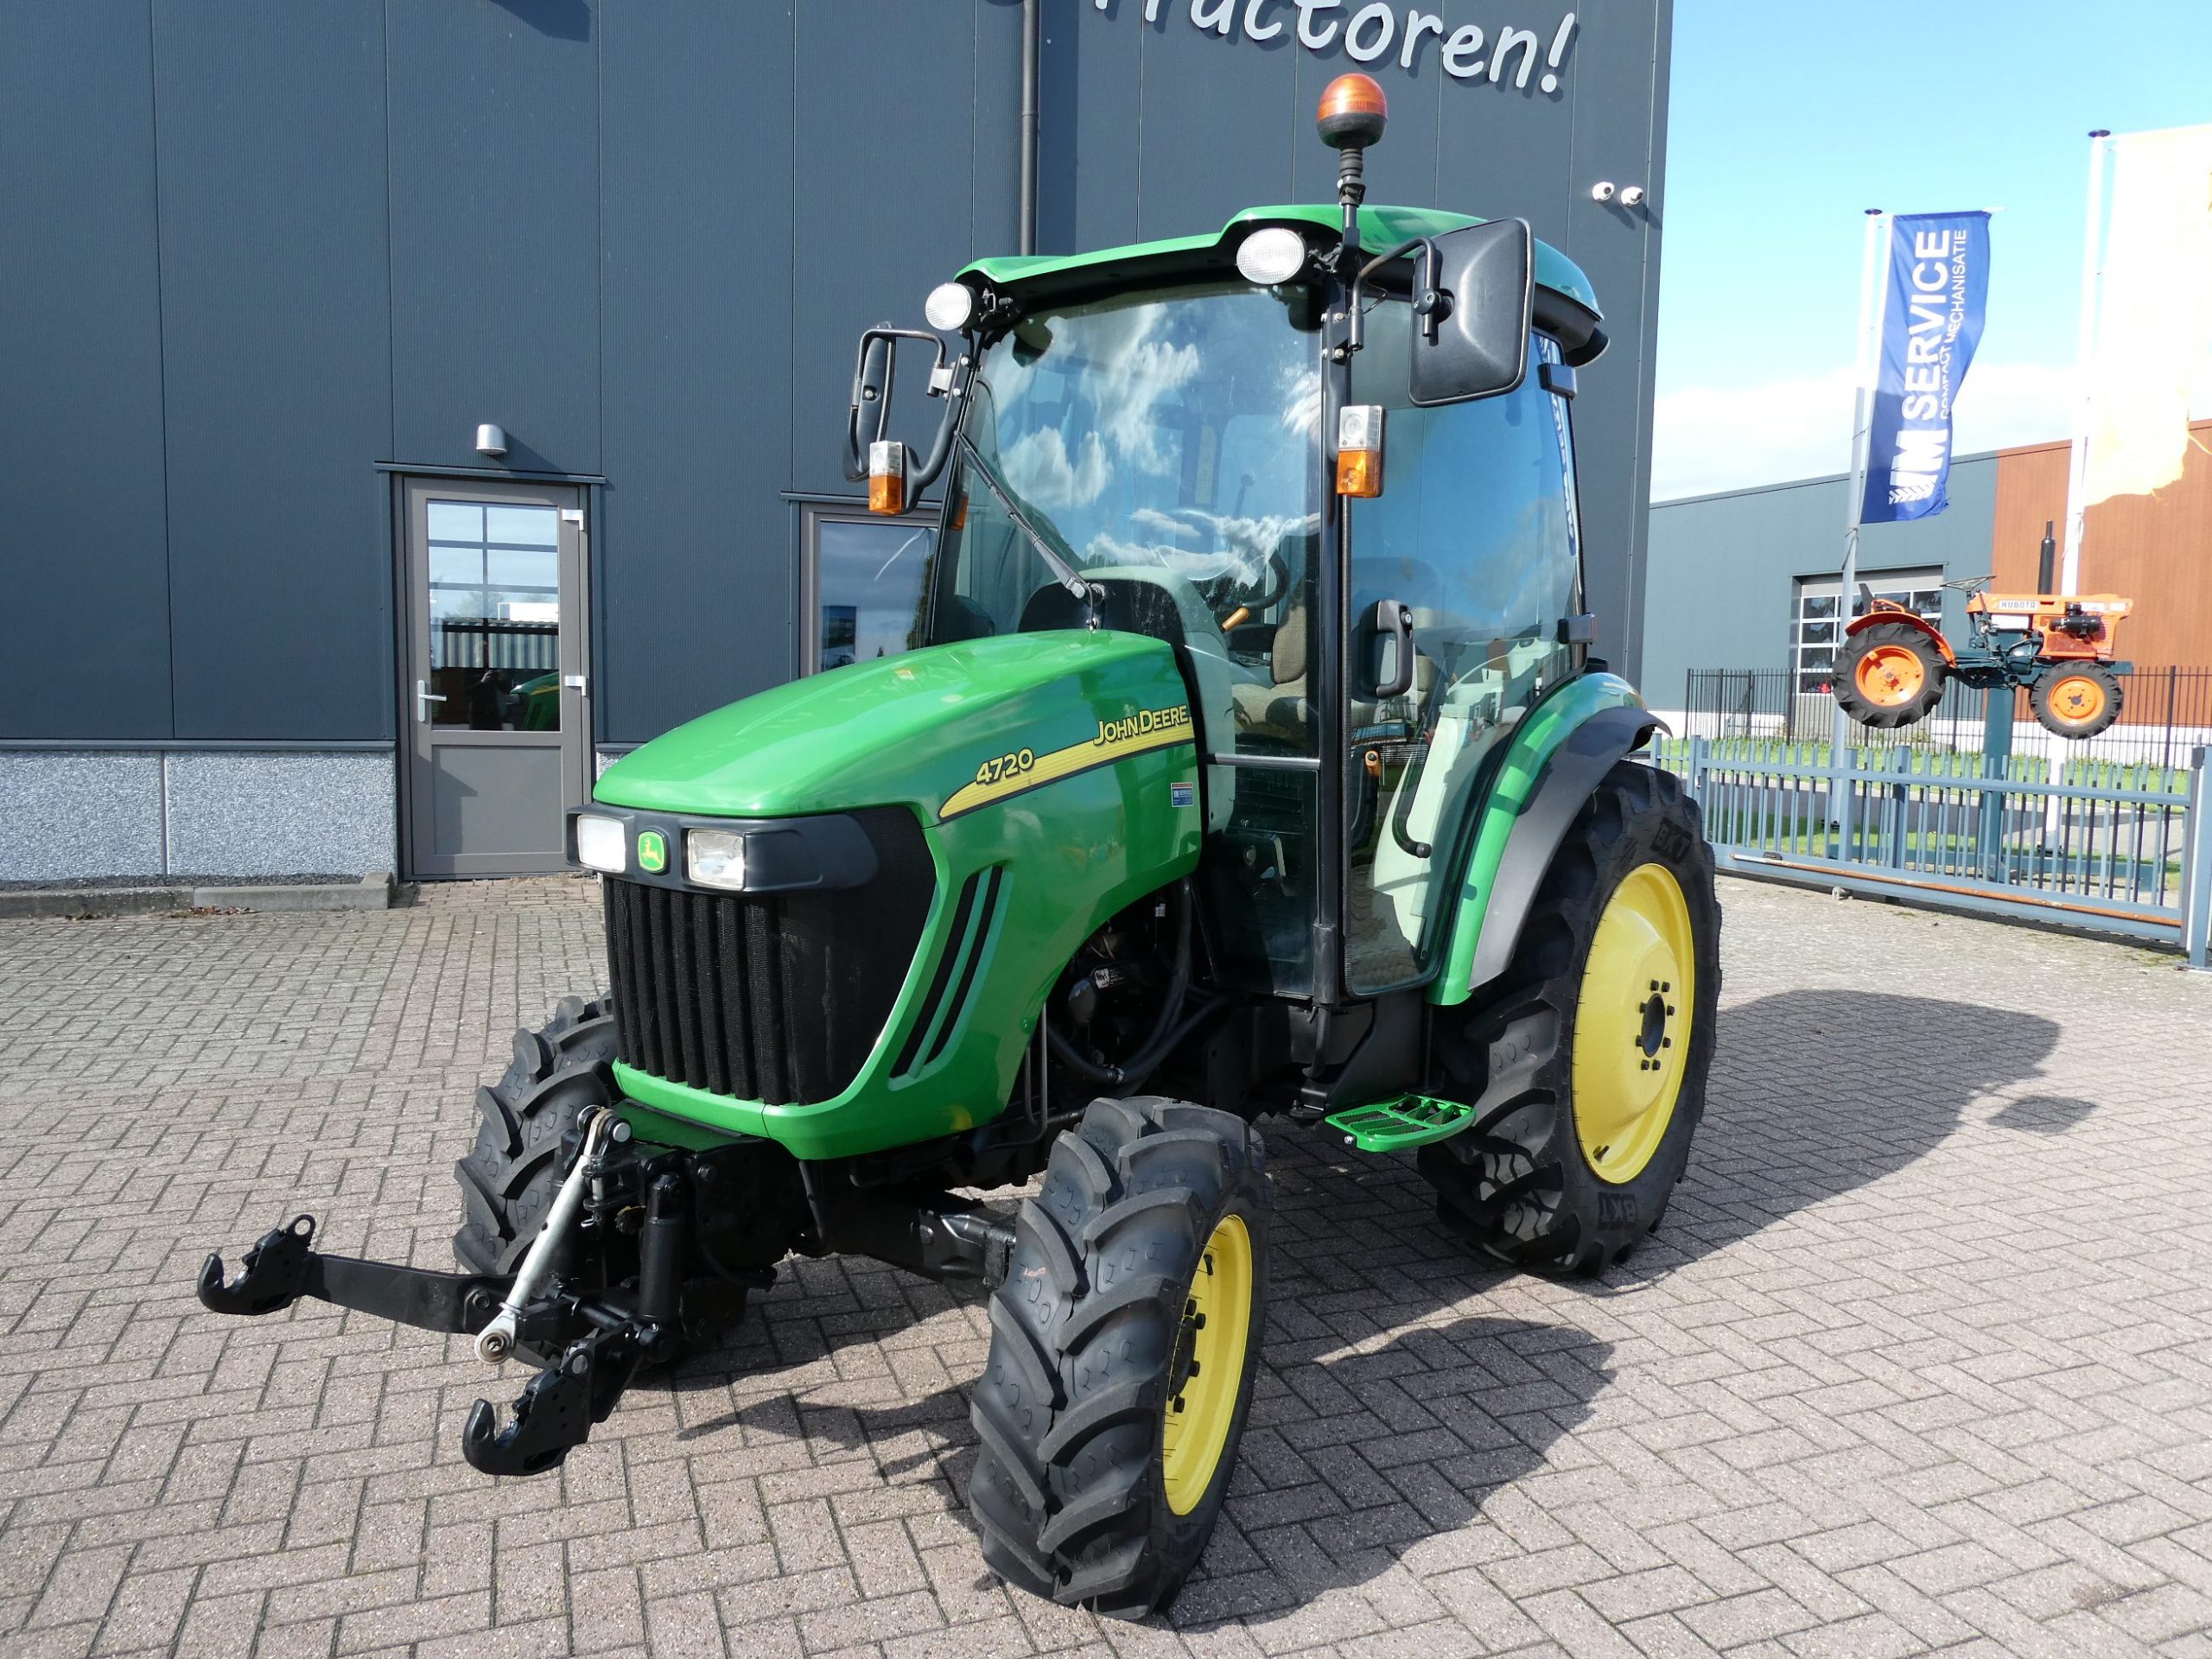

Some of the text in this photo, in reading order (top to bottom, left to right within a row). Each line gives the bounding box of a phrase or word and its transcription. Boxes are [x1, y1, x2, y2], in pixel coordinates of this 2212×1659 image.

[1096, 0, 1575, 92] actoren!
[1901, 230, 1950, 421] SERVICE
[1939, 229, 1967, 420] COMPACT MECHANISATIE
[2001, 601, 2036, 609] KUBOTA
[1093, 704, 1188, 746] JOHN DEERE
[976, 748, 1034, 784] 4720
[1654, 820, 1692, 862] BKT
[1599, 1193, 1637, 1226] BKT
